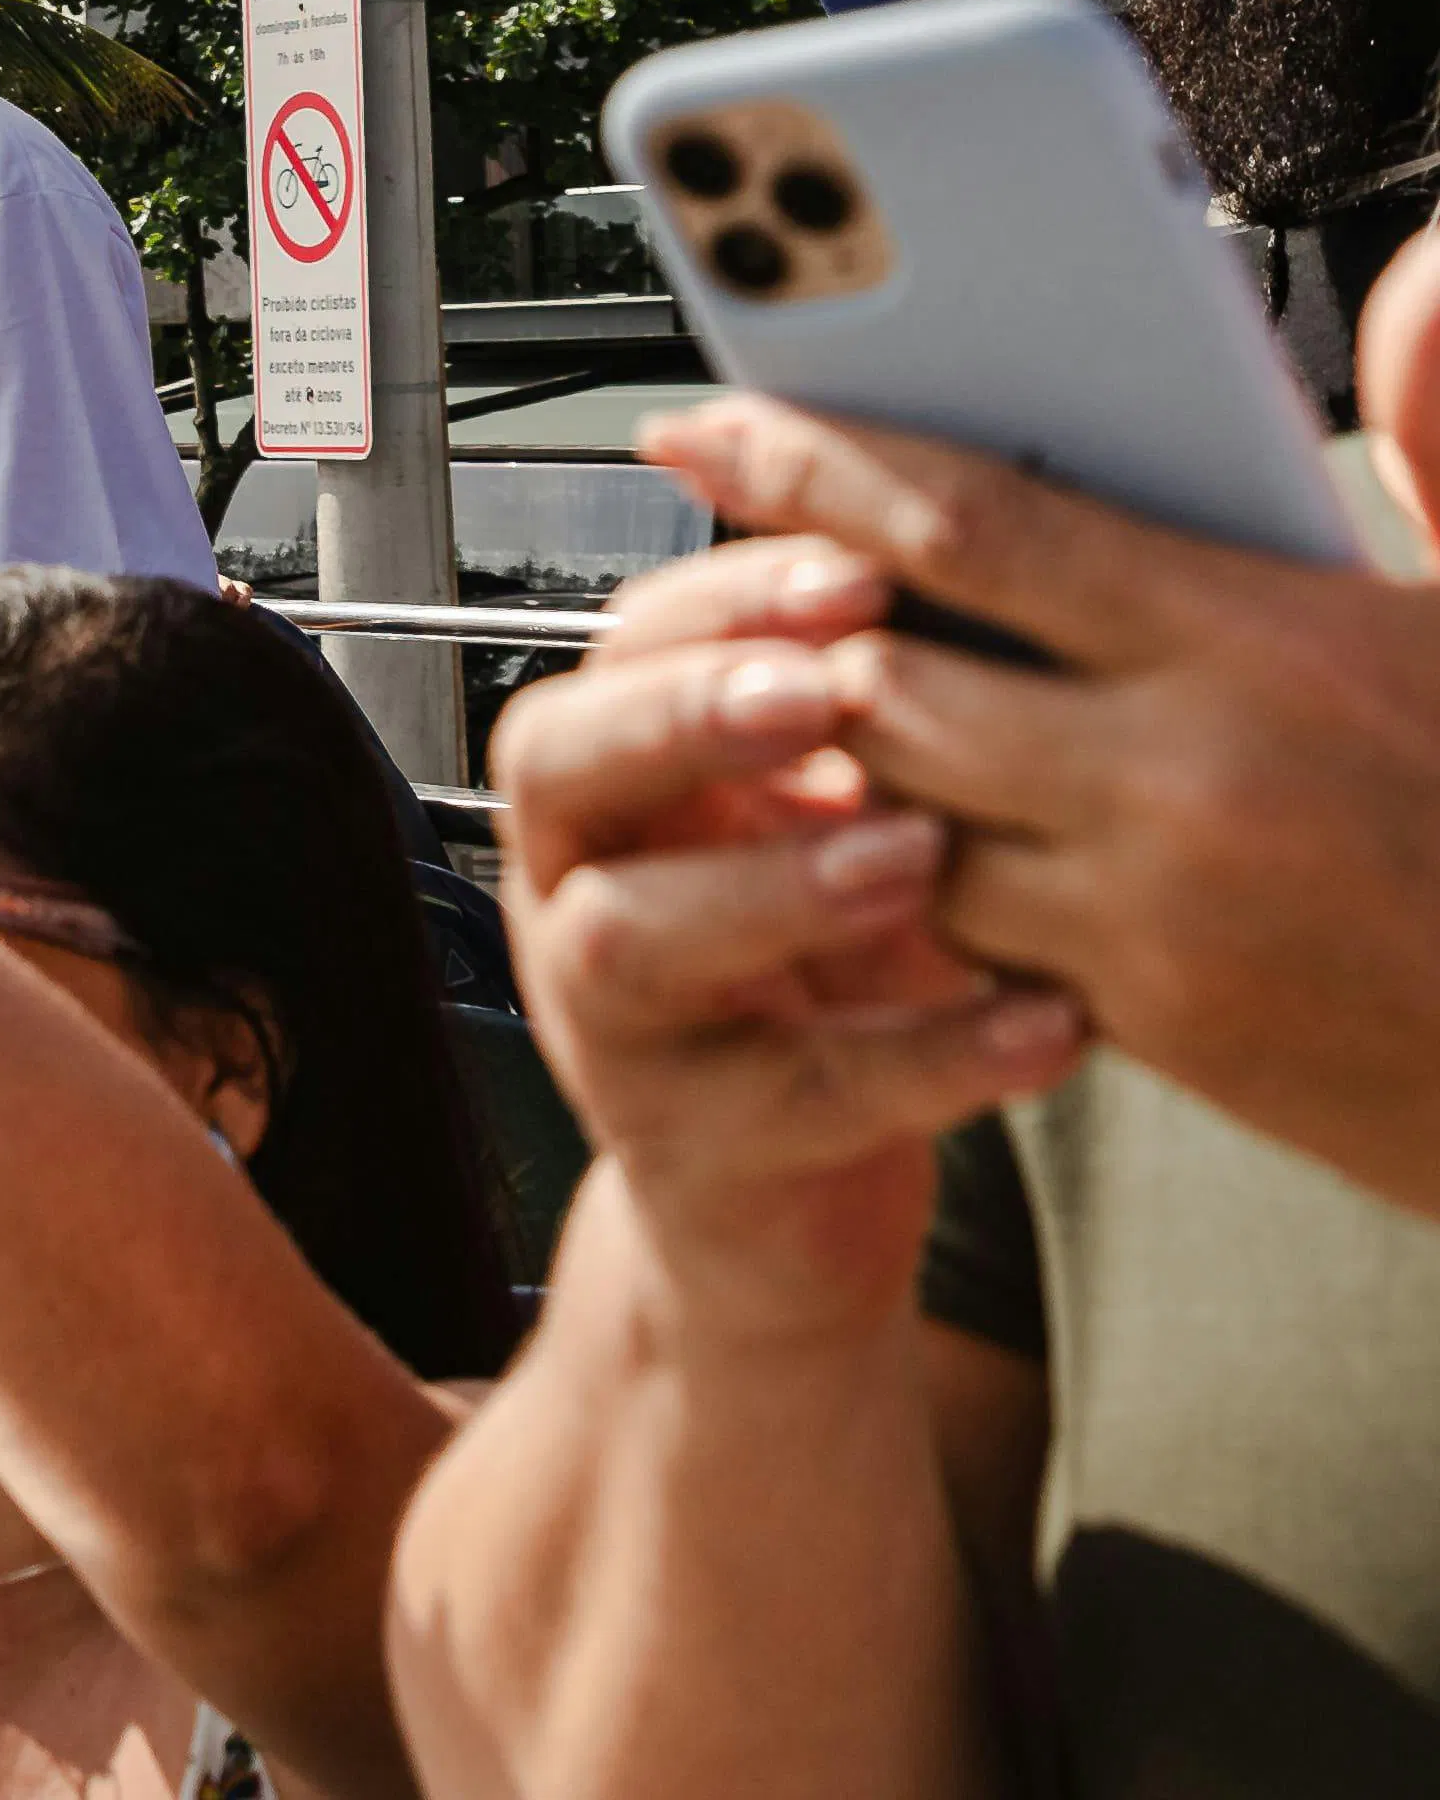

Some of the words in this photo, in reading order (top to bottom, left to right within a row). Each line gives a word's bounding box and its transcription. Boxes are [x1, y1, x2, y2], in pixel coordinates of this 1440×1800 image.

[262, 295, 308, 312] Proibido
[310, 293, 357, 311] ciclistas
[270, 325, 292, 343] fora
[295, 326, 308, 342] da
[310, 324, 353, 342] ciclovia
[269, 358, 305, 374] exceto
[307, 358, 355, 374] menores
[284, 386, 302, 402] até
[317, 389, 343, 403] anos
[263, 420, 298, 435] Decreto
